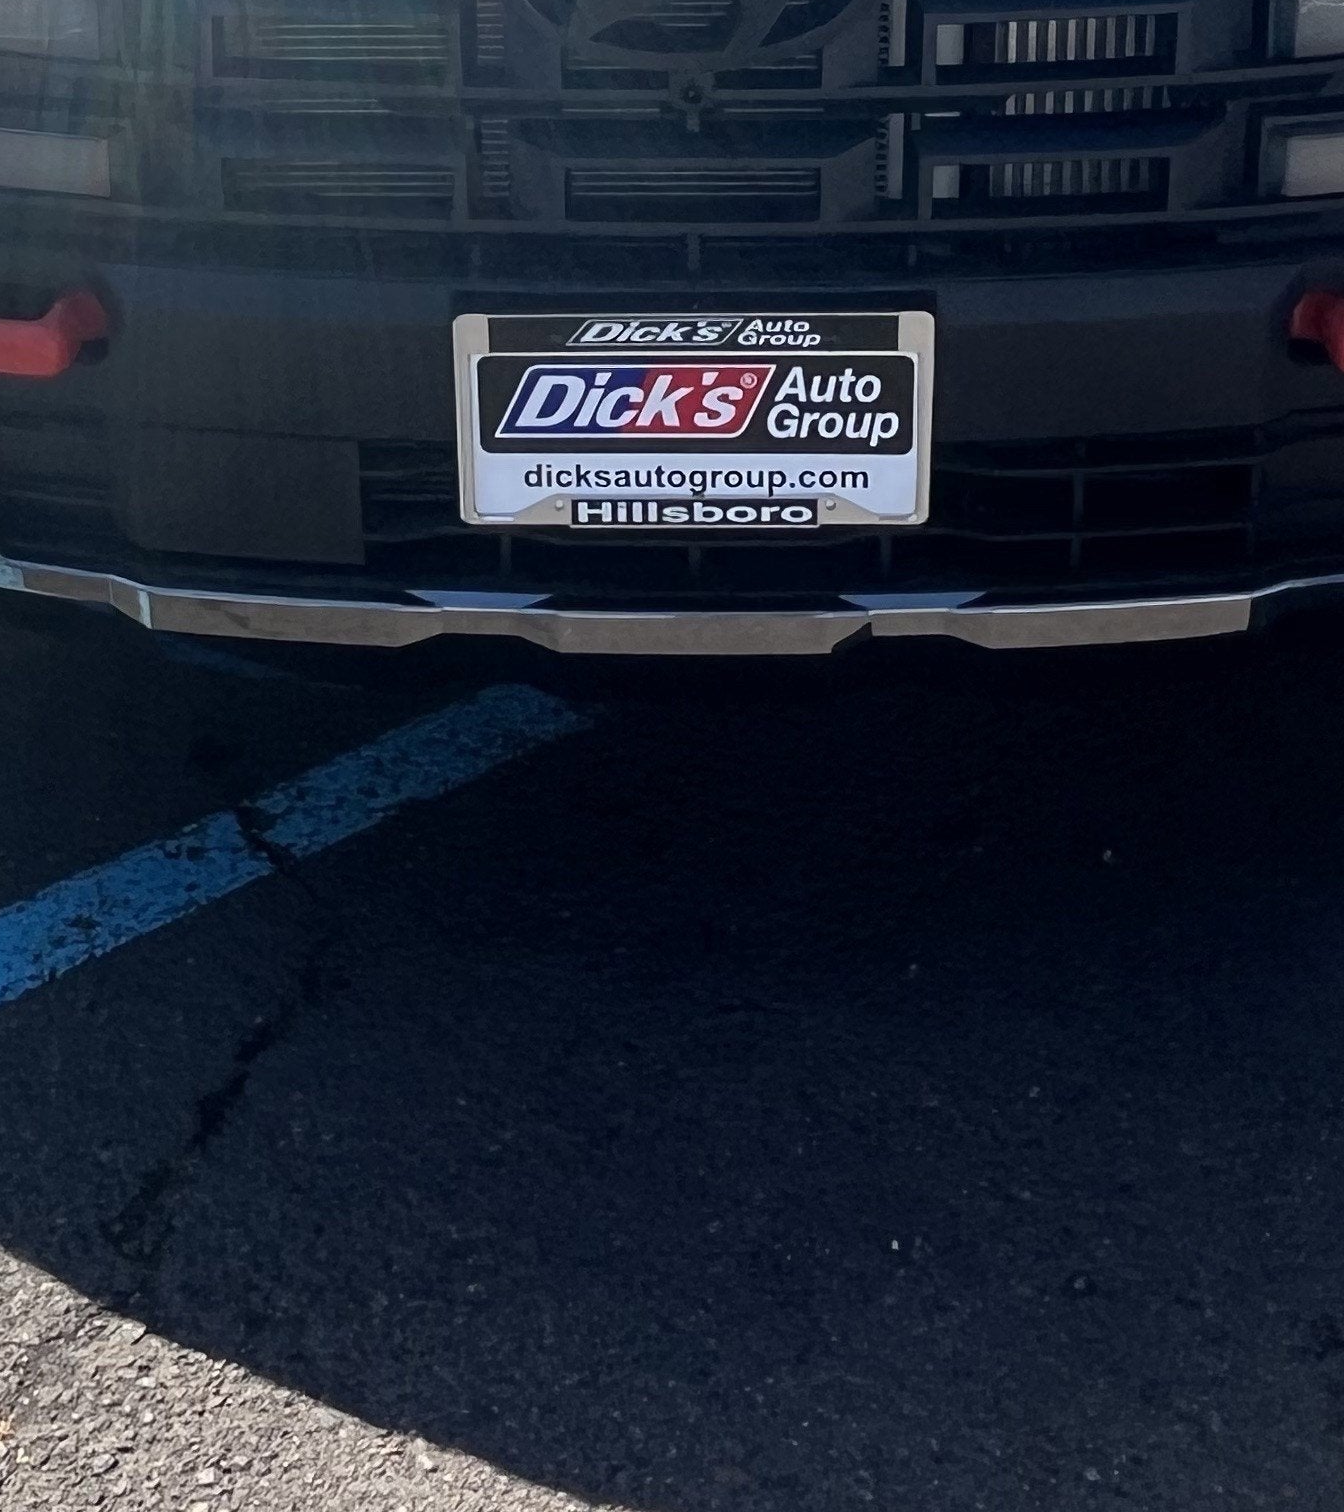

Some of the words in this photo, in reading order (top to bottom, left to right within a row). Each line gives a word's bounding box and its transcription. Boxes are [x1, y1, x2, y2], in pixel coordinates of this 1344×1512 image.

[579, 321, 724, 343] Dick's
[746, 318, 810, 333] Auto
[737, 331, 822, 348] Group
[514, 370, 744, 429] Dick's
[773, 366, 883, 404] Auto
[766, 403, 899, 447] Group
[523, 464, 870, 497] dicksautogroup.com
[576, 501, 814, 524] Hillsboro
